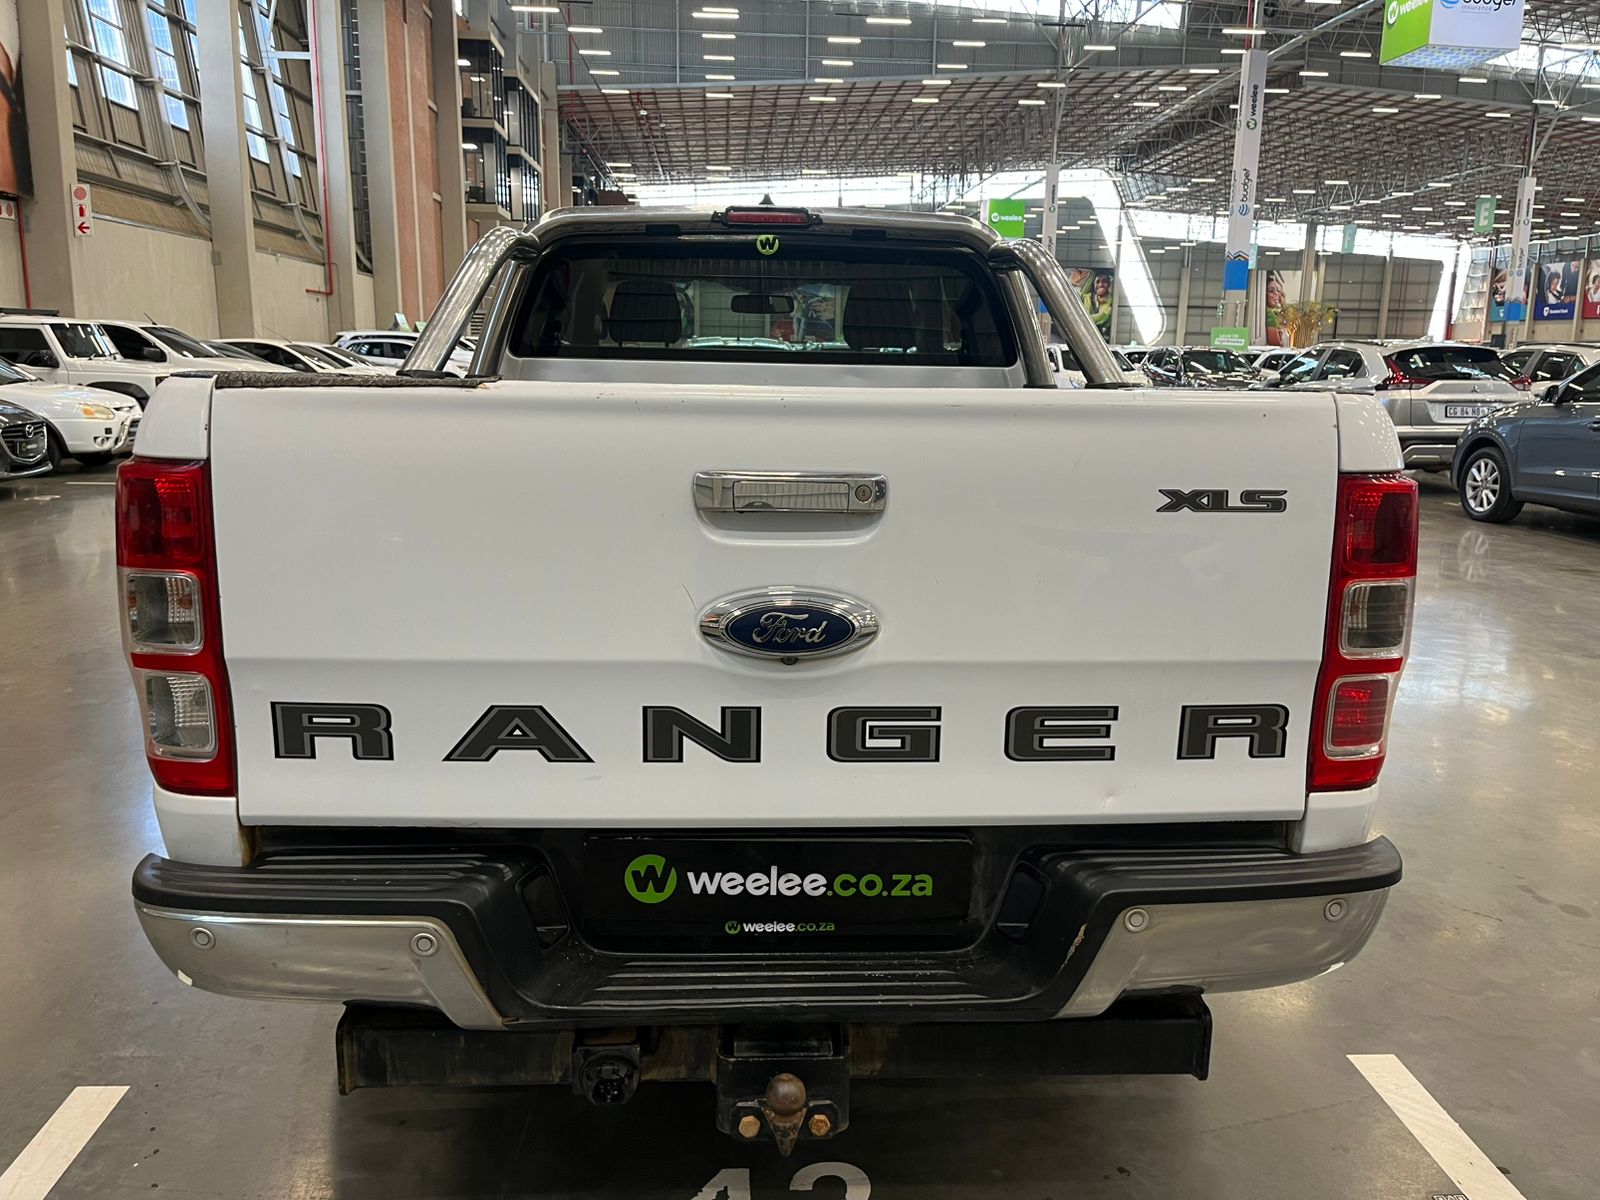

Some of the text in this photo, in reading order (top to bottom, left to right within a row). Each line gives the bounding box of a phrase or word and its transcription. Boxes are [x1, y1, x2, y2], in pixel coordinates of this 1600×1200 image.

[1250, 84, 1258, 117] weelee
[1240, 168, 1252, 202] budget
[1479, 202, 1490, 226] E
[1156, 489, 1288, 513] XLS
[752, 611, 828, 644] Ford
[270, 701, 1289, 763] RANGER
[687, 865, 933, 897] weelee.co.za
[743, 921, 835, 933] weelee.co.za
